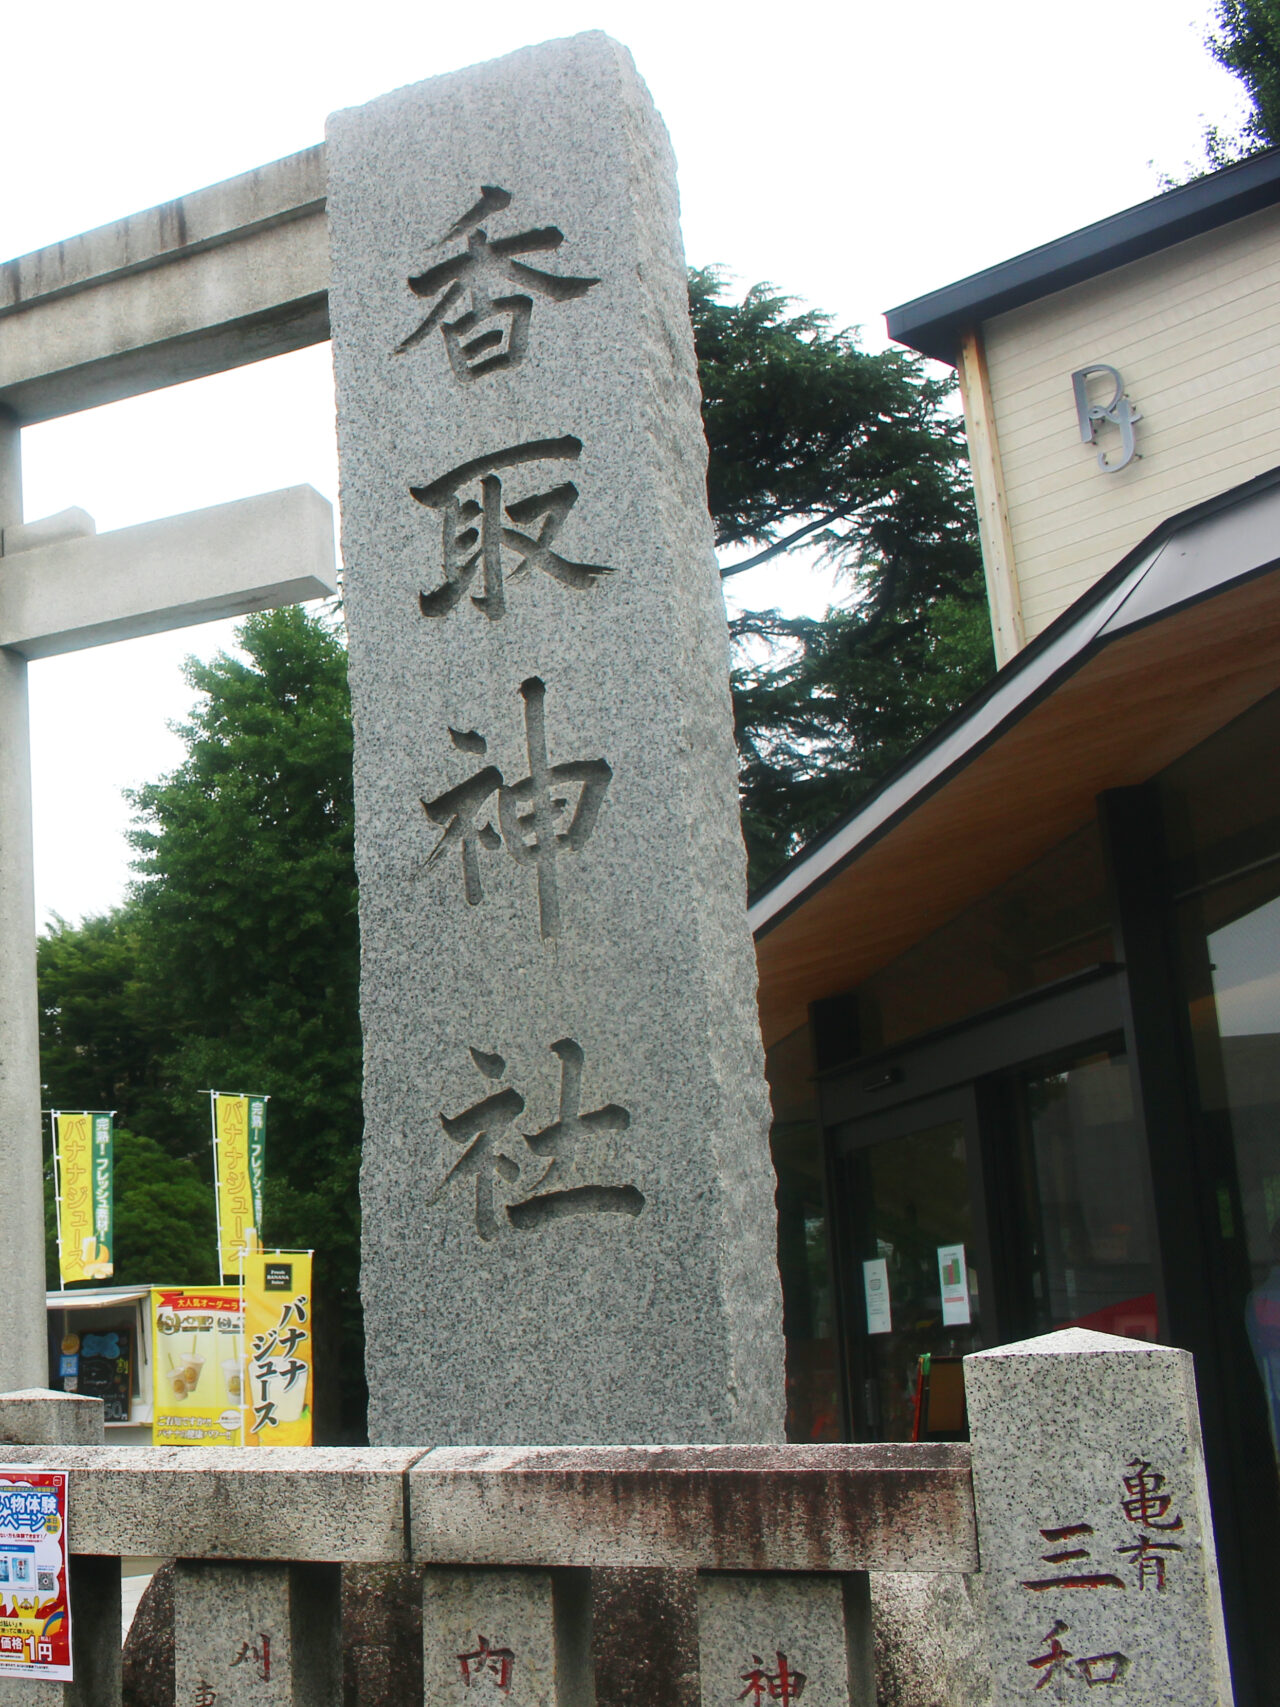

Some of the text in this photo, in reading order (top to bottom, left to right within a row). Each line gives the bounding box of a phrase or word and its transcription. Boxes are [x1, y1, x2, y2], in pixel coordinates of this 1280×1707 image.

[392, 185, 646, 1243] 香取神社
[63, 1118, 88, 1271] バナナジュース
[223, 1101, 249, 1262] バナナジュース
[250, 1329, 280, 1433] ジュース
[278, 1295, 308, 1392] バナナ
[1115, 1457, 1184, 1592] 亀有
[456, 1634, 515, 1694] 内
[735, 1650, 808, 1707] 神
[1021, 1522, 1132, 1703] 三和
